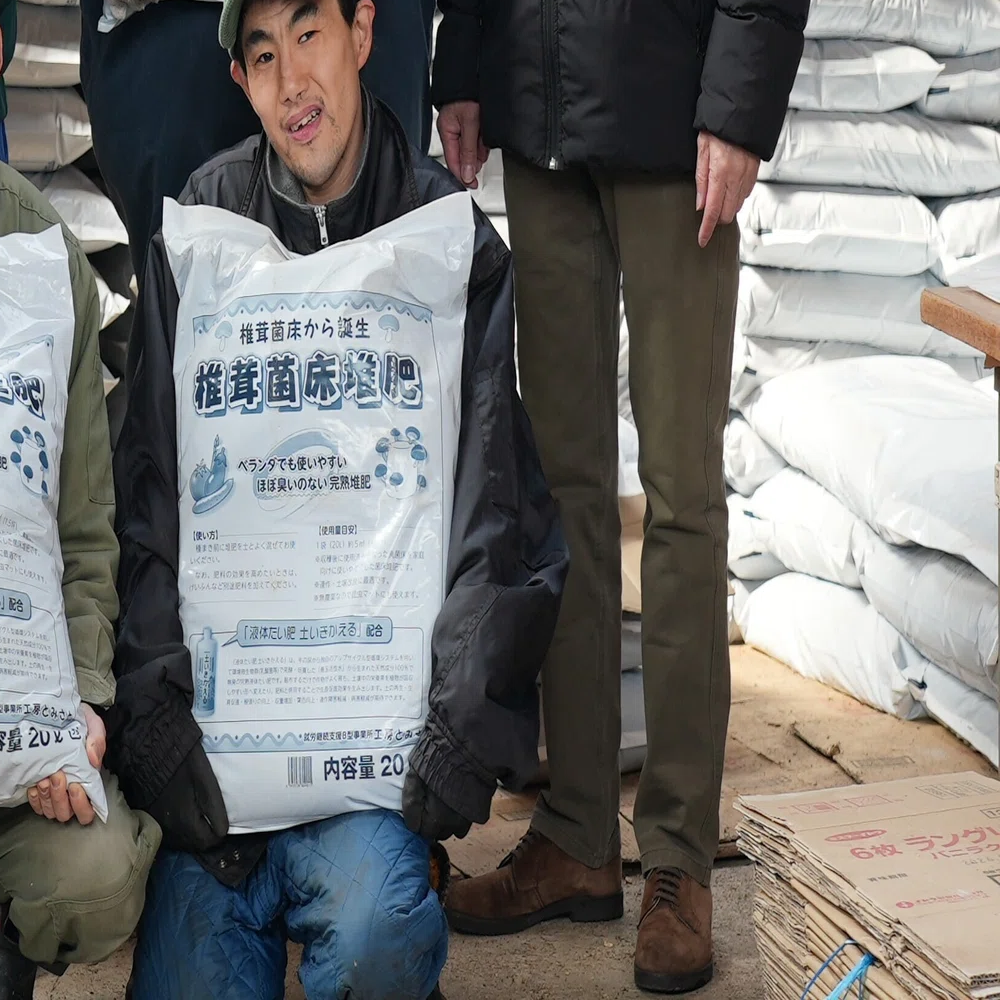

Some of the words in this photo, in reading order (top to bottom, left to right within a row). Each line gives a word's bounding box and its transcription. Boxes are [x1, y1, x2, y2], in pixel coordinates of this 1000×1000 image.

[239, 317, 370, 346] 椎茸菌床から誕生
[193, 350, 423, 418] 椎茸菌床堆肥
[238, 455, 348, 473] ベランダでも使いやすい
[193, 529, 219, 541] 【使い方】
[319, 524, 357, 536] 【使用量目安】
[324, 755, 376, 781] 内容量
[380, 753, 404, 777] 20
